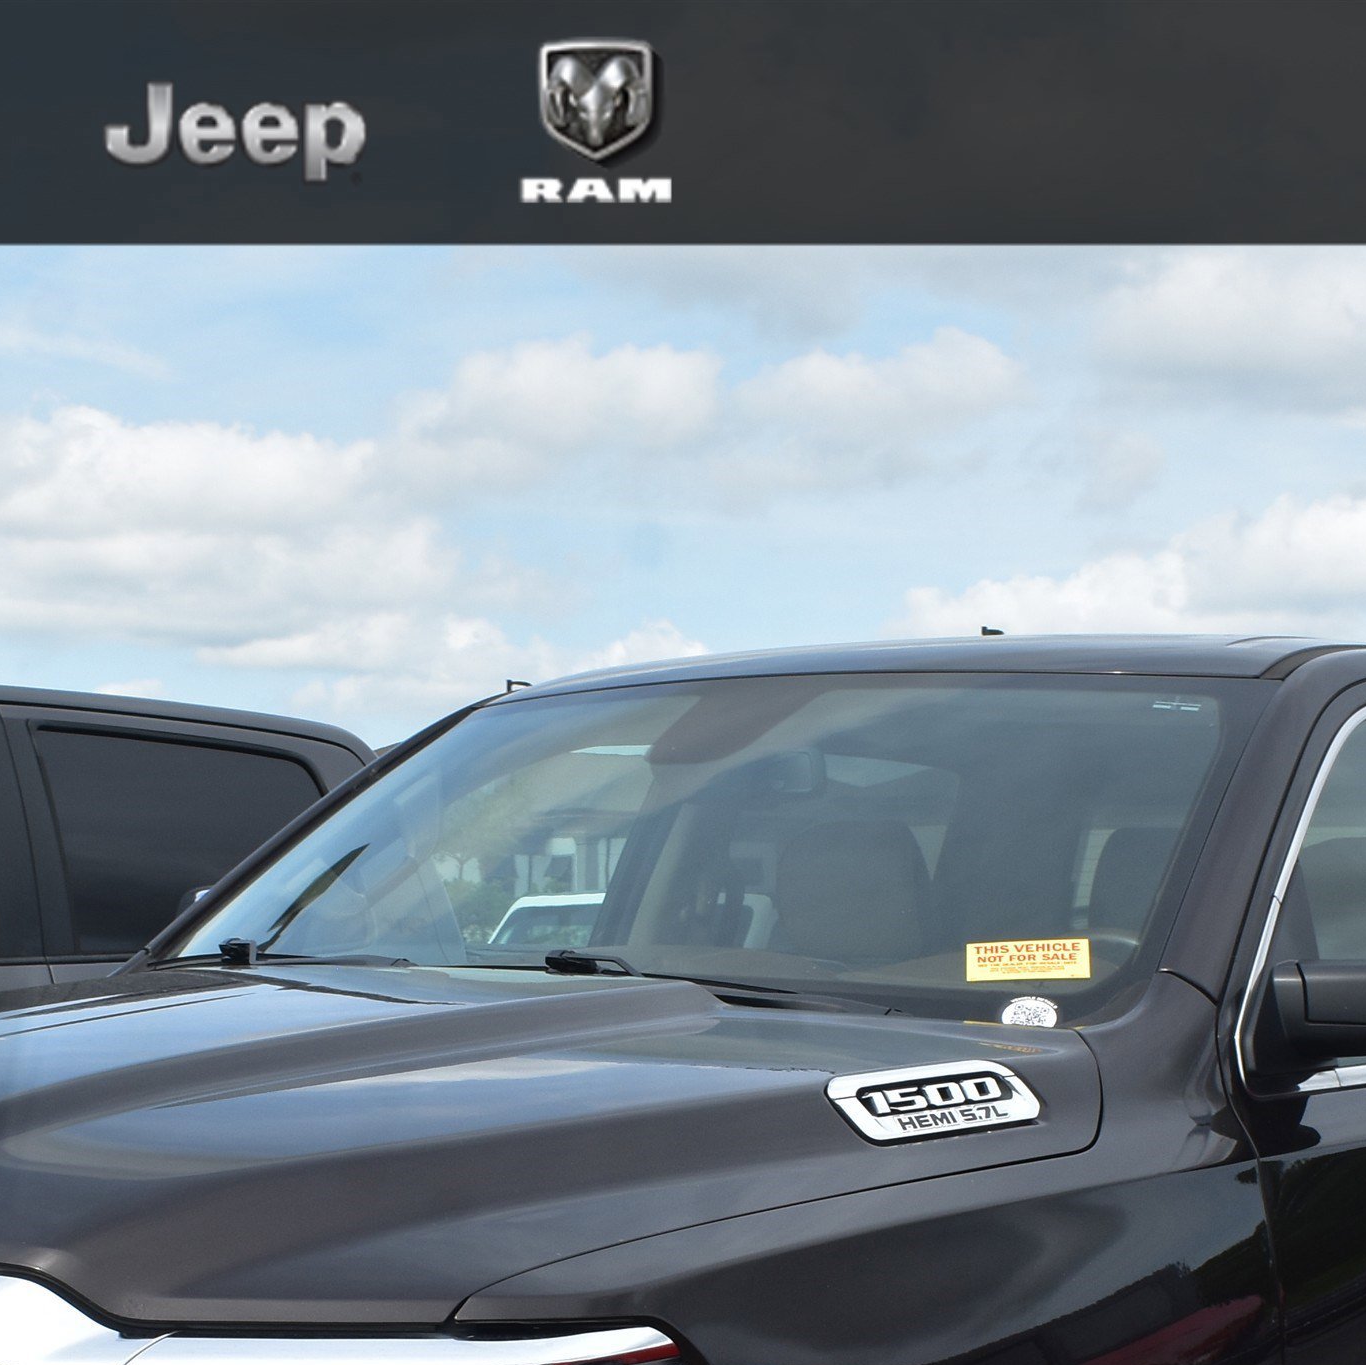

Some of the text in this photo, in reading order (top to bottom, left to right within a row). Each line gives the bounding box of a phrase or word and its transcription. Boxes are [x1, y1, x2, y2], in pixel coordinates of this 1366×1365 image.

[974, 942, 1081, 955] THIS VEHICLE
[1009, 954, 1037, 962] FOR
[1042, 953, 1077, 961] SALE
[863, 1077, 1002, 1114] 1500
[897, 1104, 1009, 1131] HEMI 5.7L
